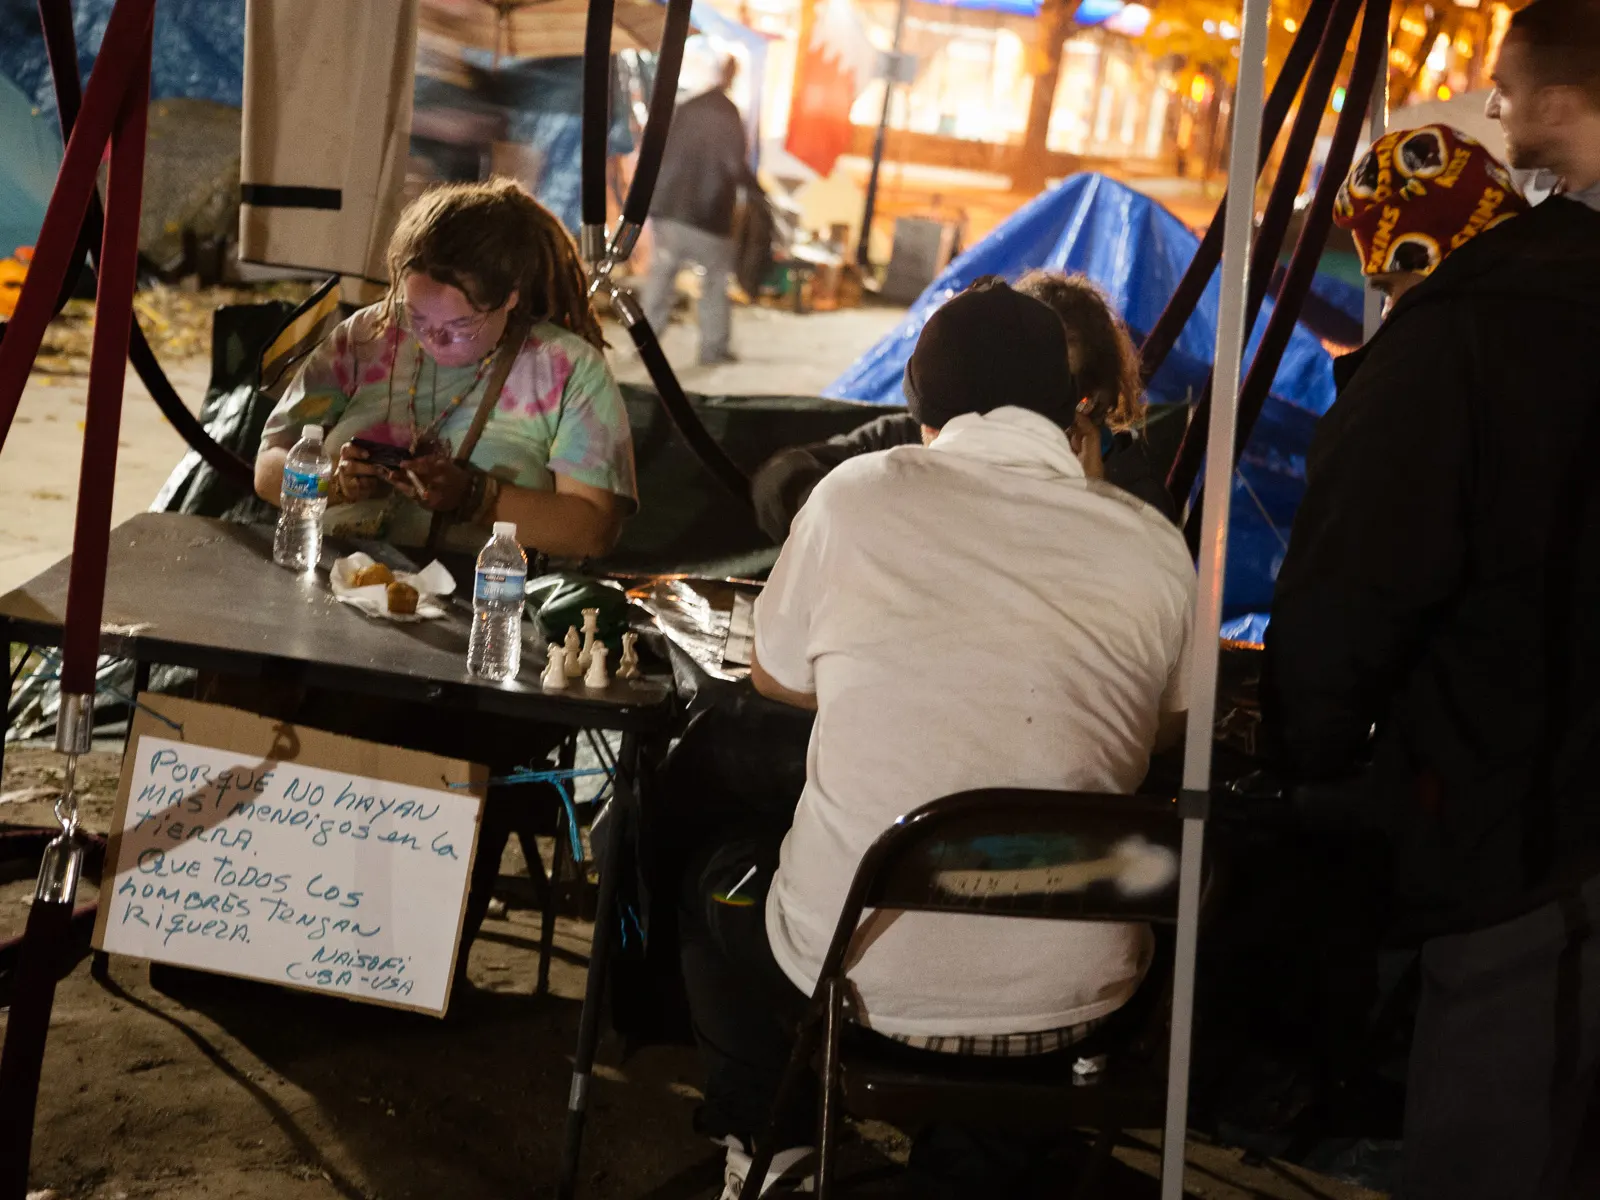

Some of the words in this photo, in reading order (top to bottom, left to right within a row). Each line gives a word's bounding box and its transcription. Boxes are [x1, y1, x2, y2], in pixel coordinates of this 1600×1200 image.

[283, 777, 325, 806] NO
[377, 830, 421, 851] en
[137, 848, 201, 878] QUe
[213, 856, 292, 893] ToDOS
